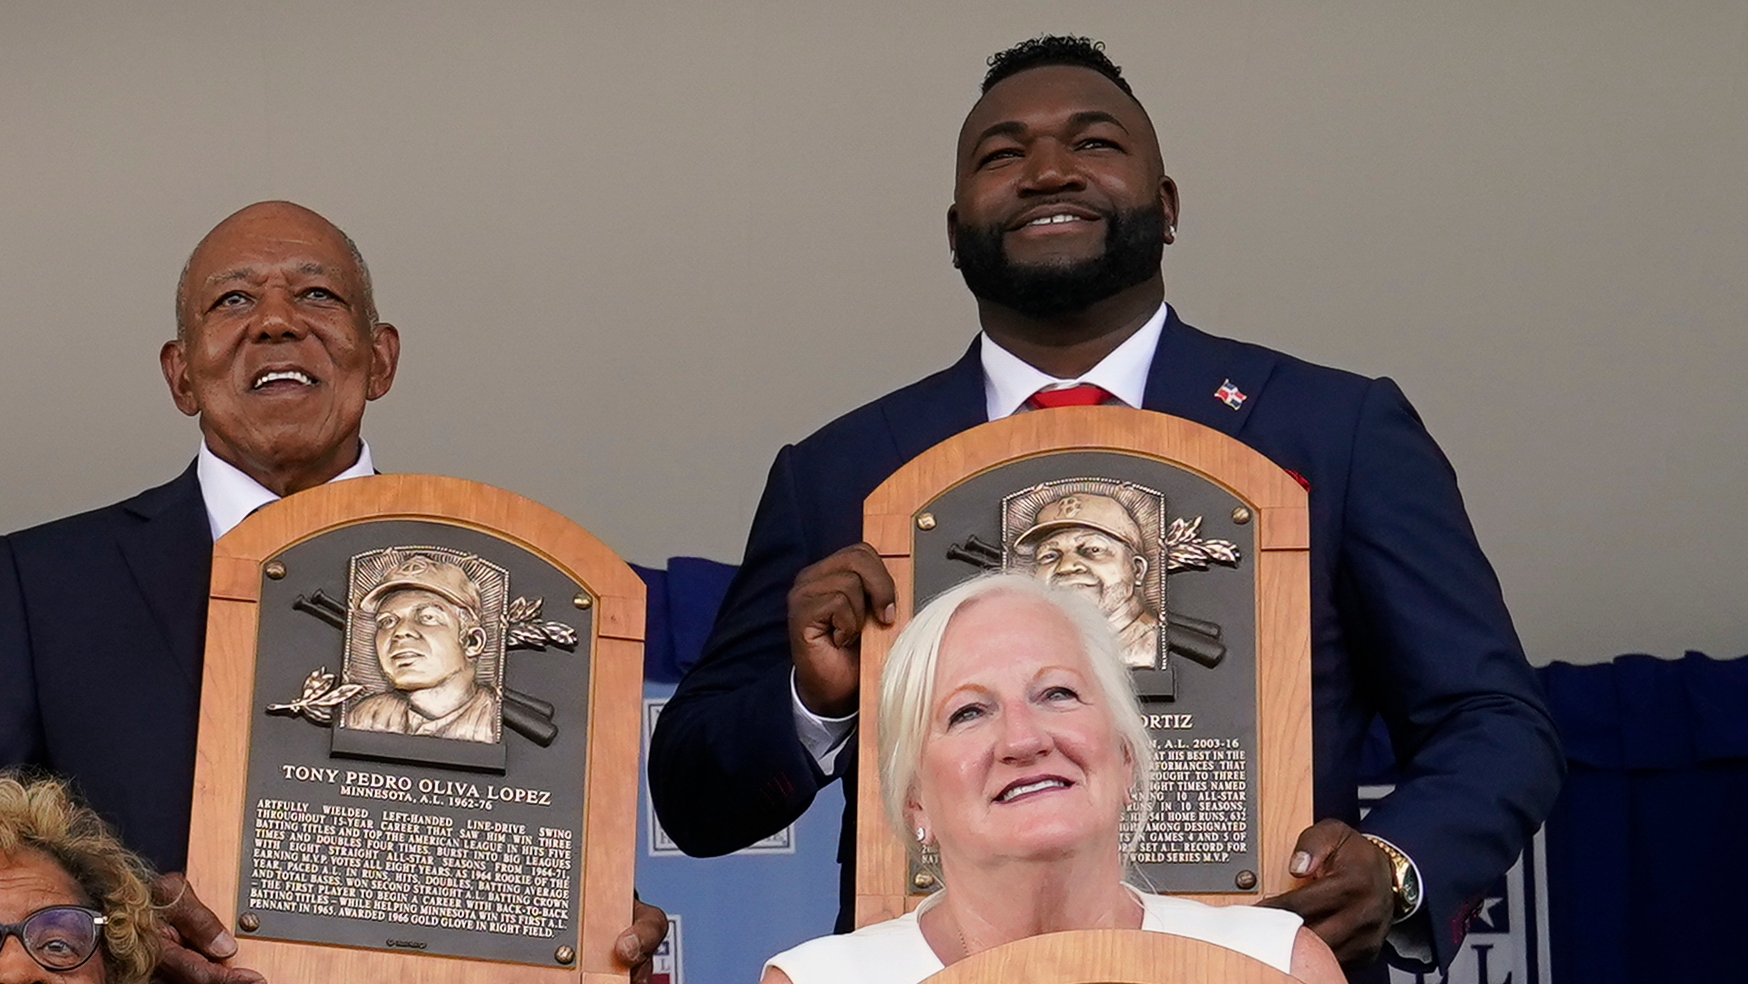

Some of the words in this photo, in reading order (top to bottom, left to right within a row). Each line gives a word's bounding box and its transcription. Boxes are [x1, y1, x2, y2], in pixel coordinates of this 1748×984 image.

[1167, 751, 1184, 760] HIS
[1186, 751, 1210, 760] BEST
[1213, 750, 1224, 760] IN
[1225, 750, 1245, 760] THE
[1193, 739, 1239, 749] 2003-16
[283, 765, 337, 785] TONY
[345, 771, 411, 792] PEDRO
[418, 778, 479, 799] OLIVA
[487, 785, 552, 806] LOPEZ
[341, 786, 416, 803] MINNESOTA,
[449, 796, 493, 810] 1962-76
[257, 800, 307, 814] ARTFULLY
[322, 806, 368, 820] WIELDED
[382, 812, 453, 828] LEFT-HANDED
[467, 819, 525, 835] LINE-DRIVE
[538, 826, 572, 839] SWING
